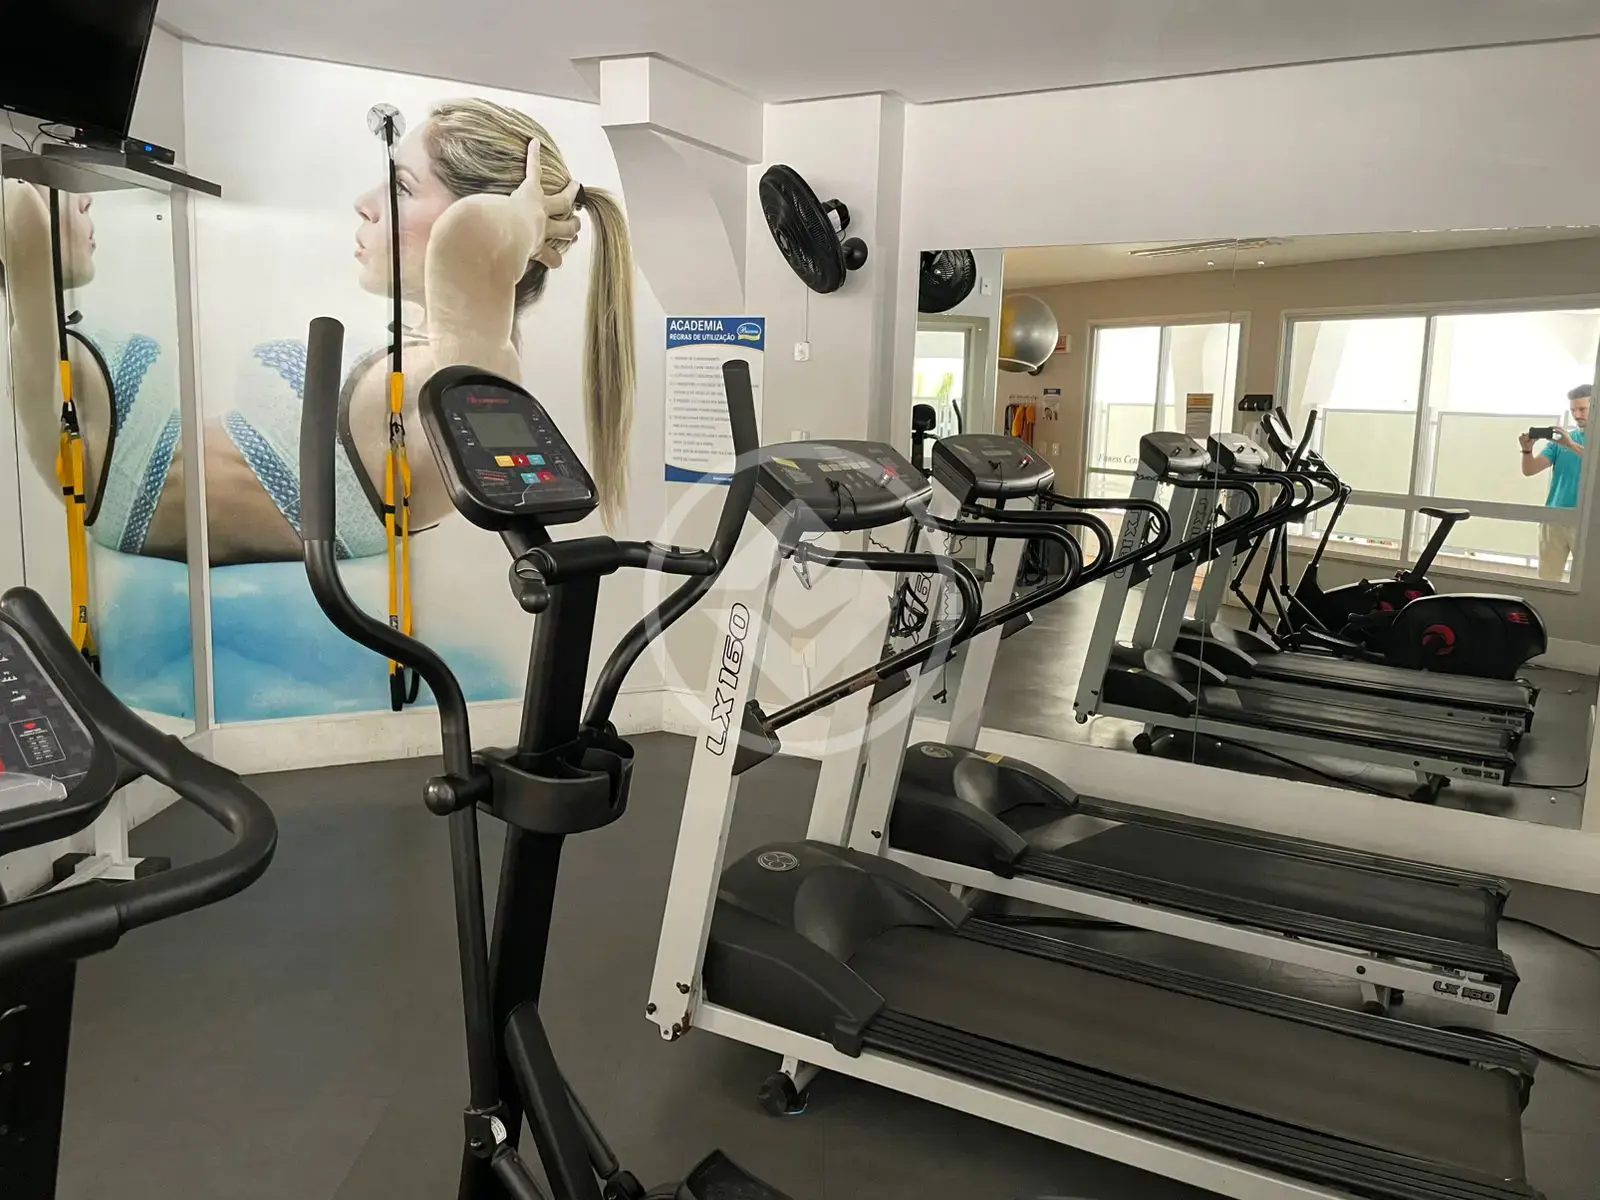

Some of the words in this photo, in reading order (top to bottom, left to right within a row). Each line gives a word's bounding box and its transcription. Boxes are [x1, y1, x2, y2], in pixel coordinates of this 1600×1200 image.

[669, 320, 724, 331] ACADEMIA
[669, 333, 692, 341] REGRAS
[702, 333, 735, 342] UTILIZAÇÃO
